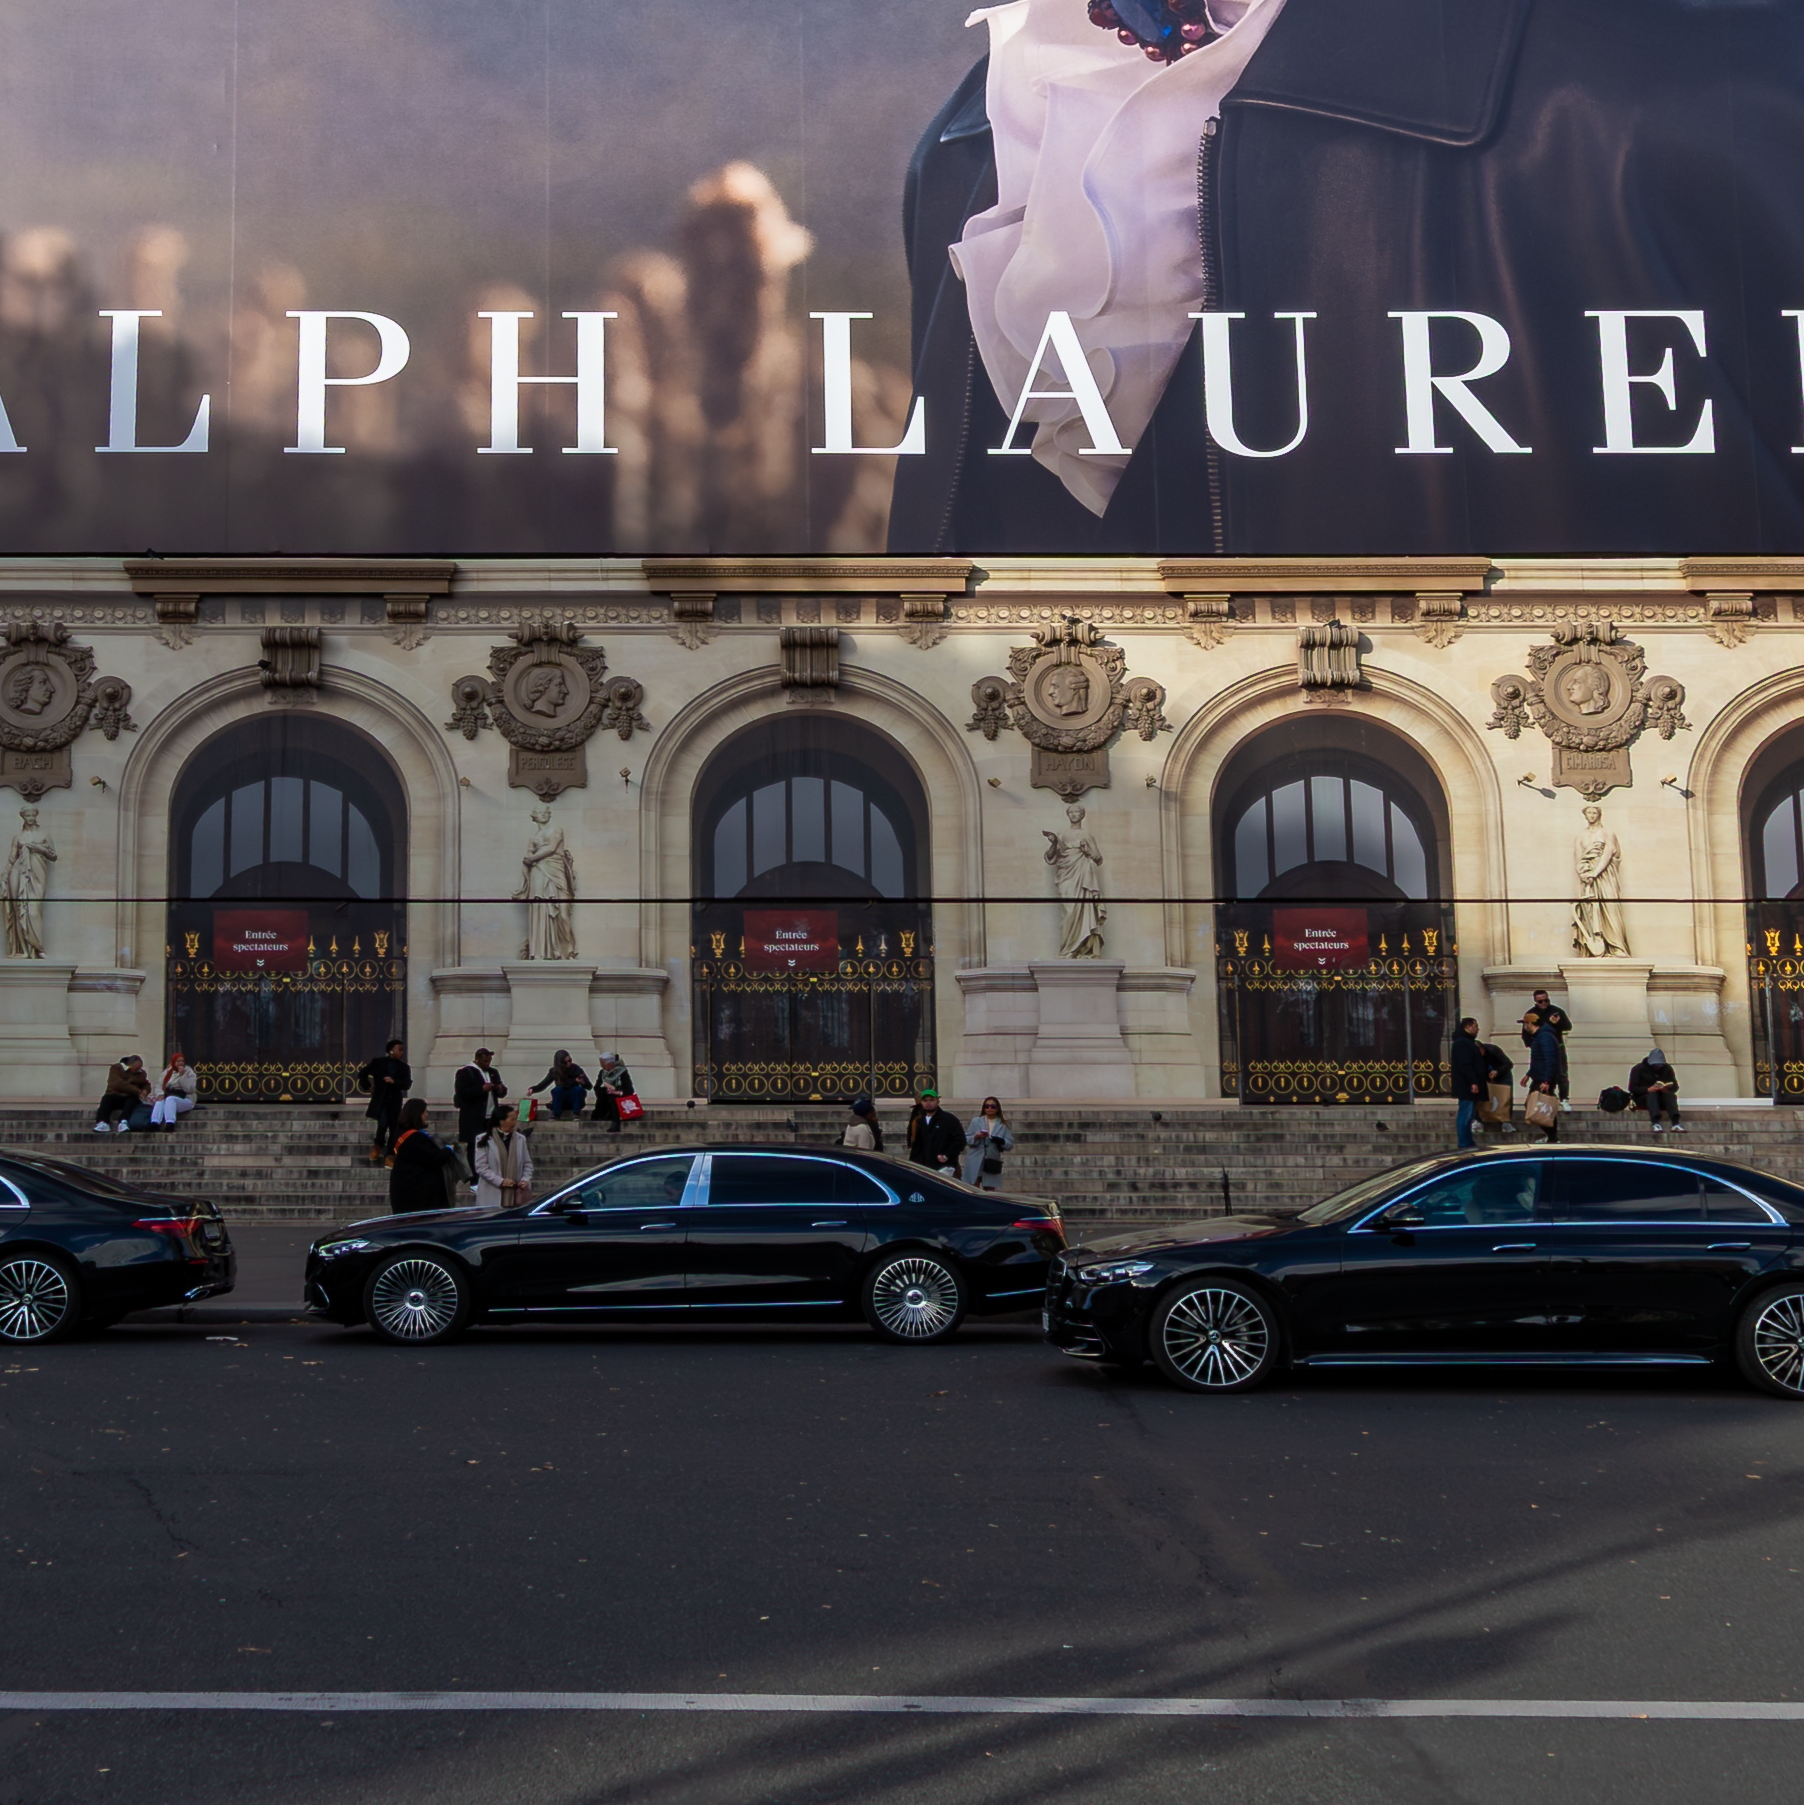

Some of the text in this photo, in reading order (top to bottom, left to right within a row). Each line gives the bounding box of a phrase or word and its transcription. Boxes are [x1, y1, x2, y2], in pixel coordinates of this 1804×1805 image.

[14, 756, 54, 770] BACH
[1046, 757, 1095, 771] HAYDN
[1566, 753, 1616, 770] CIMAROSA
[245, 930, 277, 939] Entrée
[775, 930, 807, 939] Entrée
[1305, 928, 1337, 937] Entrée
[232, 943, 289, 953] spectateurs
[763, 943, 820, 953] spectateurs
[1293, 941, 1349, 951] spectateurs
